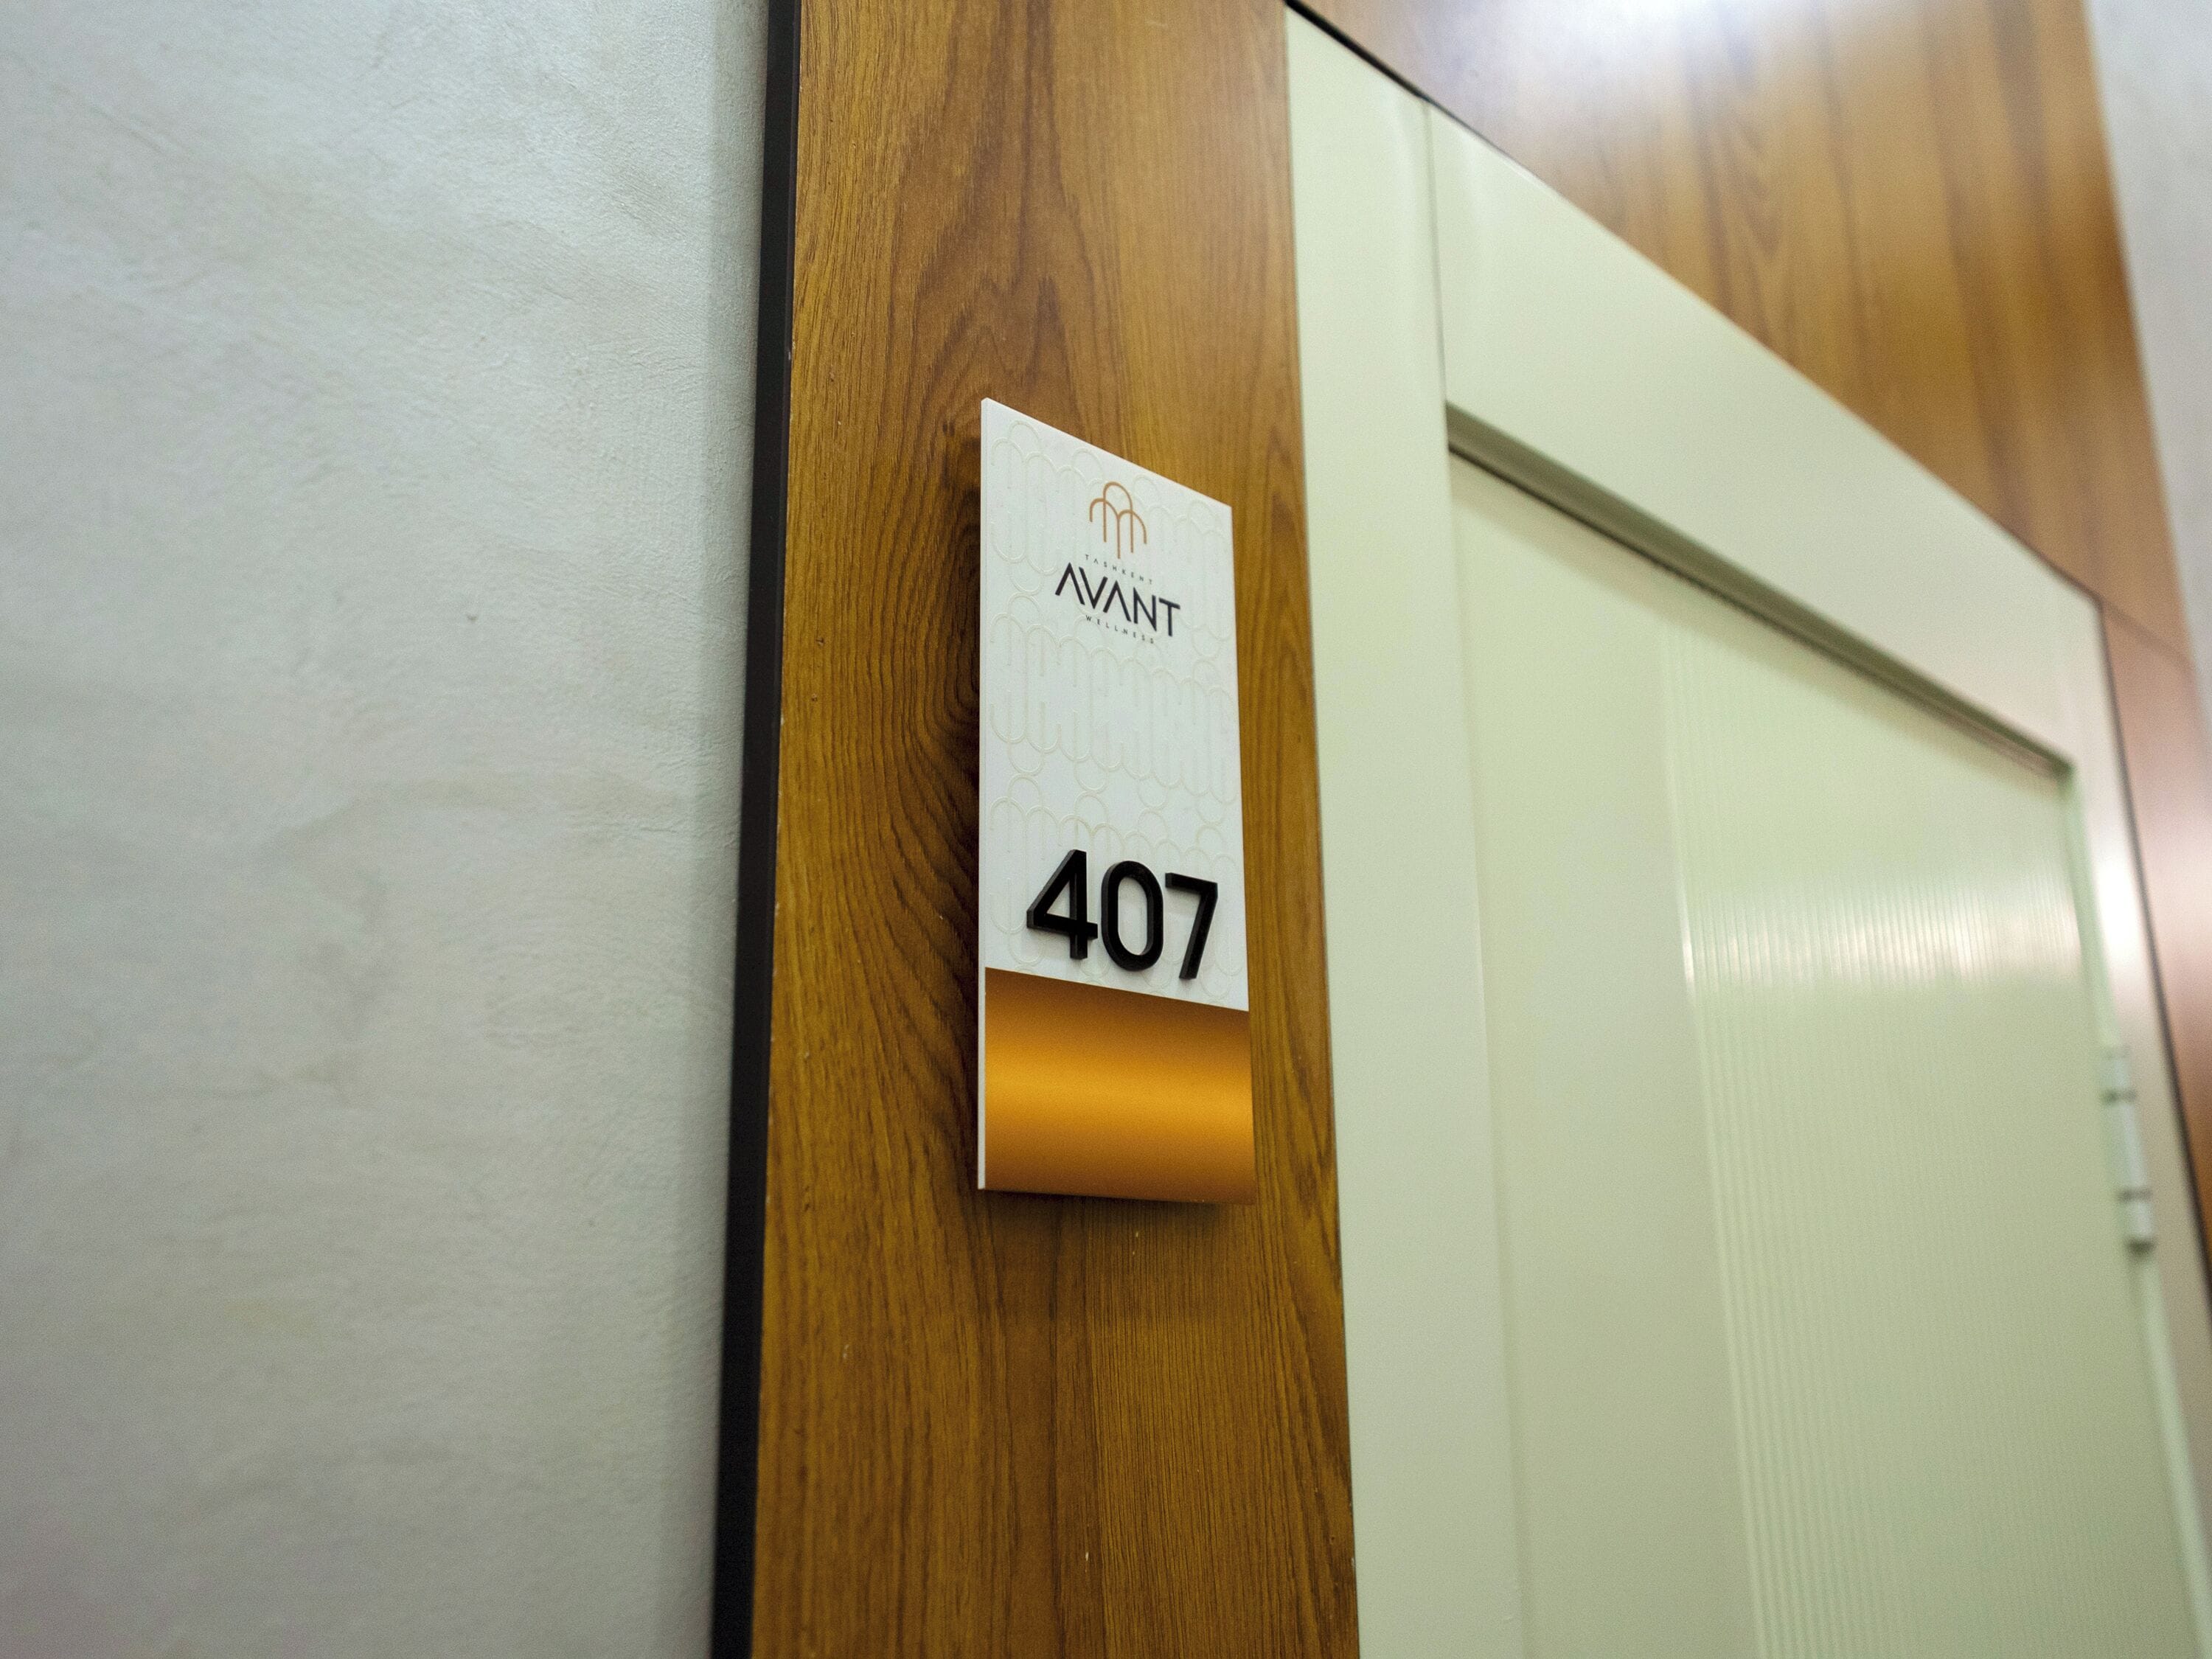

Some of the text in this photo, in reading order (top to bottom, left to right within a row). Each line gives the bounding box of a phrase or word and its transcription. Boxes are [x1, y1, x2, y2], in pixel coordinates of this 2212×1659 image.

[1085, 554, 1152, 585] TASHKENT
[1055, 562, 1180, 637] AVANT
[1086, 615, 1154, 644] WELLNESS
[1026, 849, 1217, 979] 407
